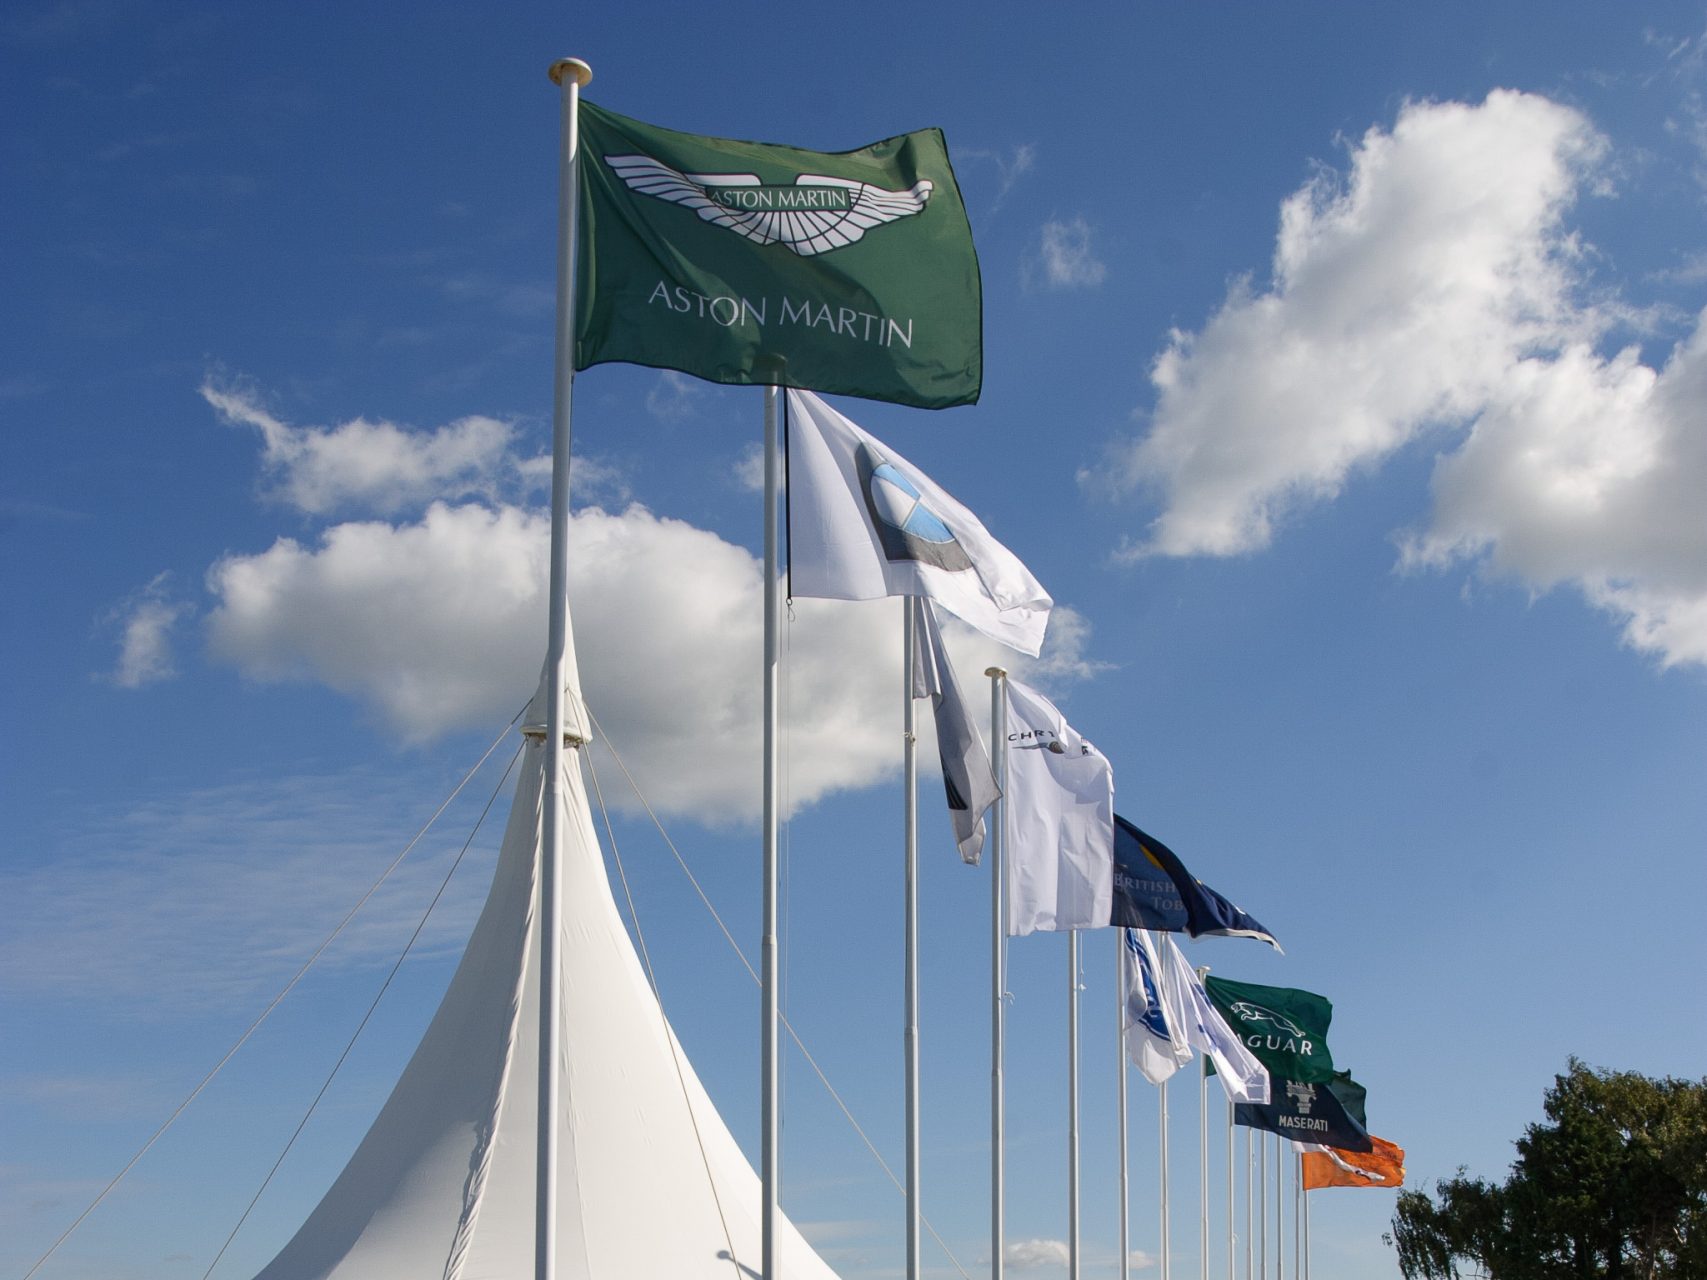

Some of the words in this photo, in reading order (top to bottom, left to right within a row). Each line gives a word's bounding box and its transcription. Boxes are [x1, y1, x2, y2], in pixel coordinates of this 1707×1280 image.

[711, 189, 772, 208] ASTON
[778, 189, 846, 208] MARTIN
[648, 280, 766, 327] ASTON
[779, 296, 913, 348] MARTIN
[1114, 873, 1177, 893] BRITISH
[1236, 1033, 1313, 1056] GUAR
[1278, 1115, 1329, 1132] MASERATI
